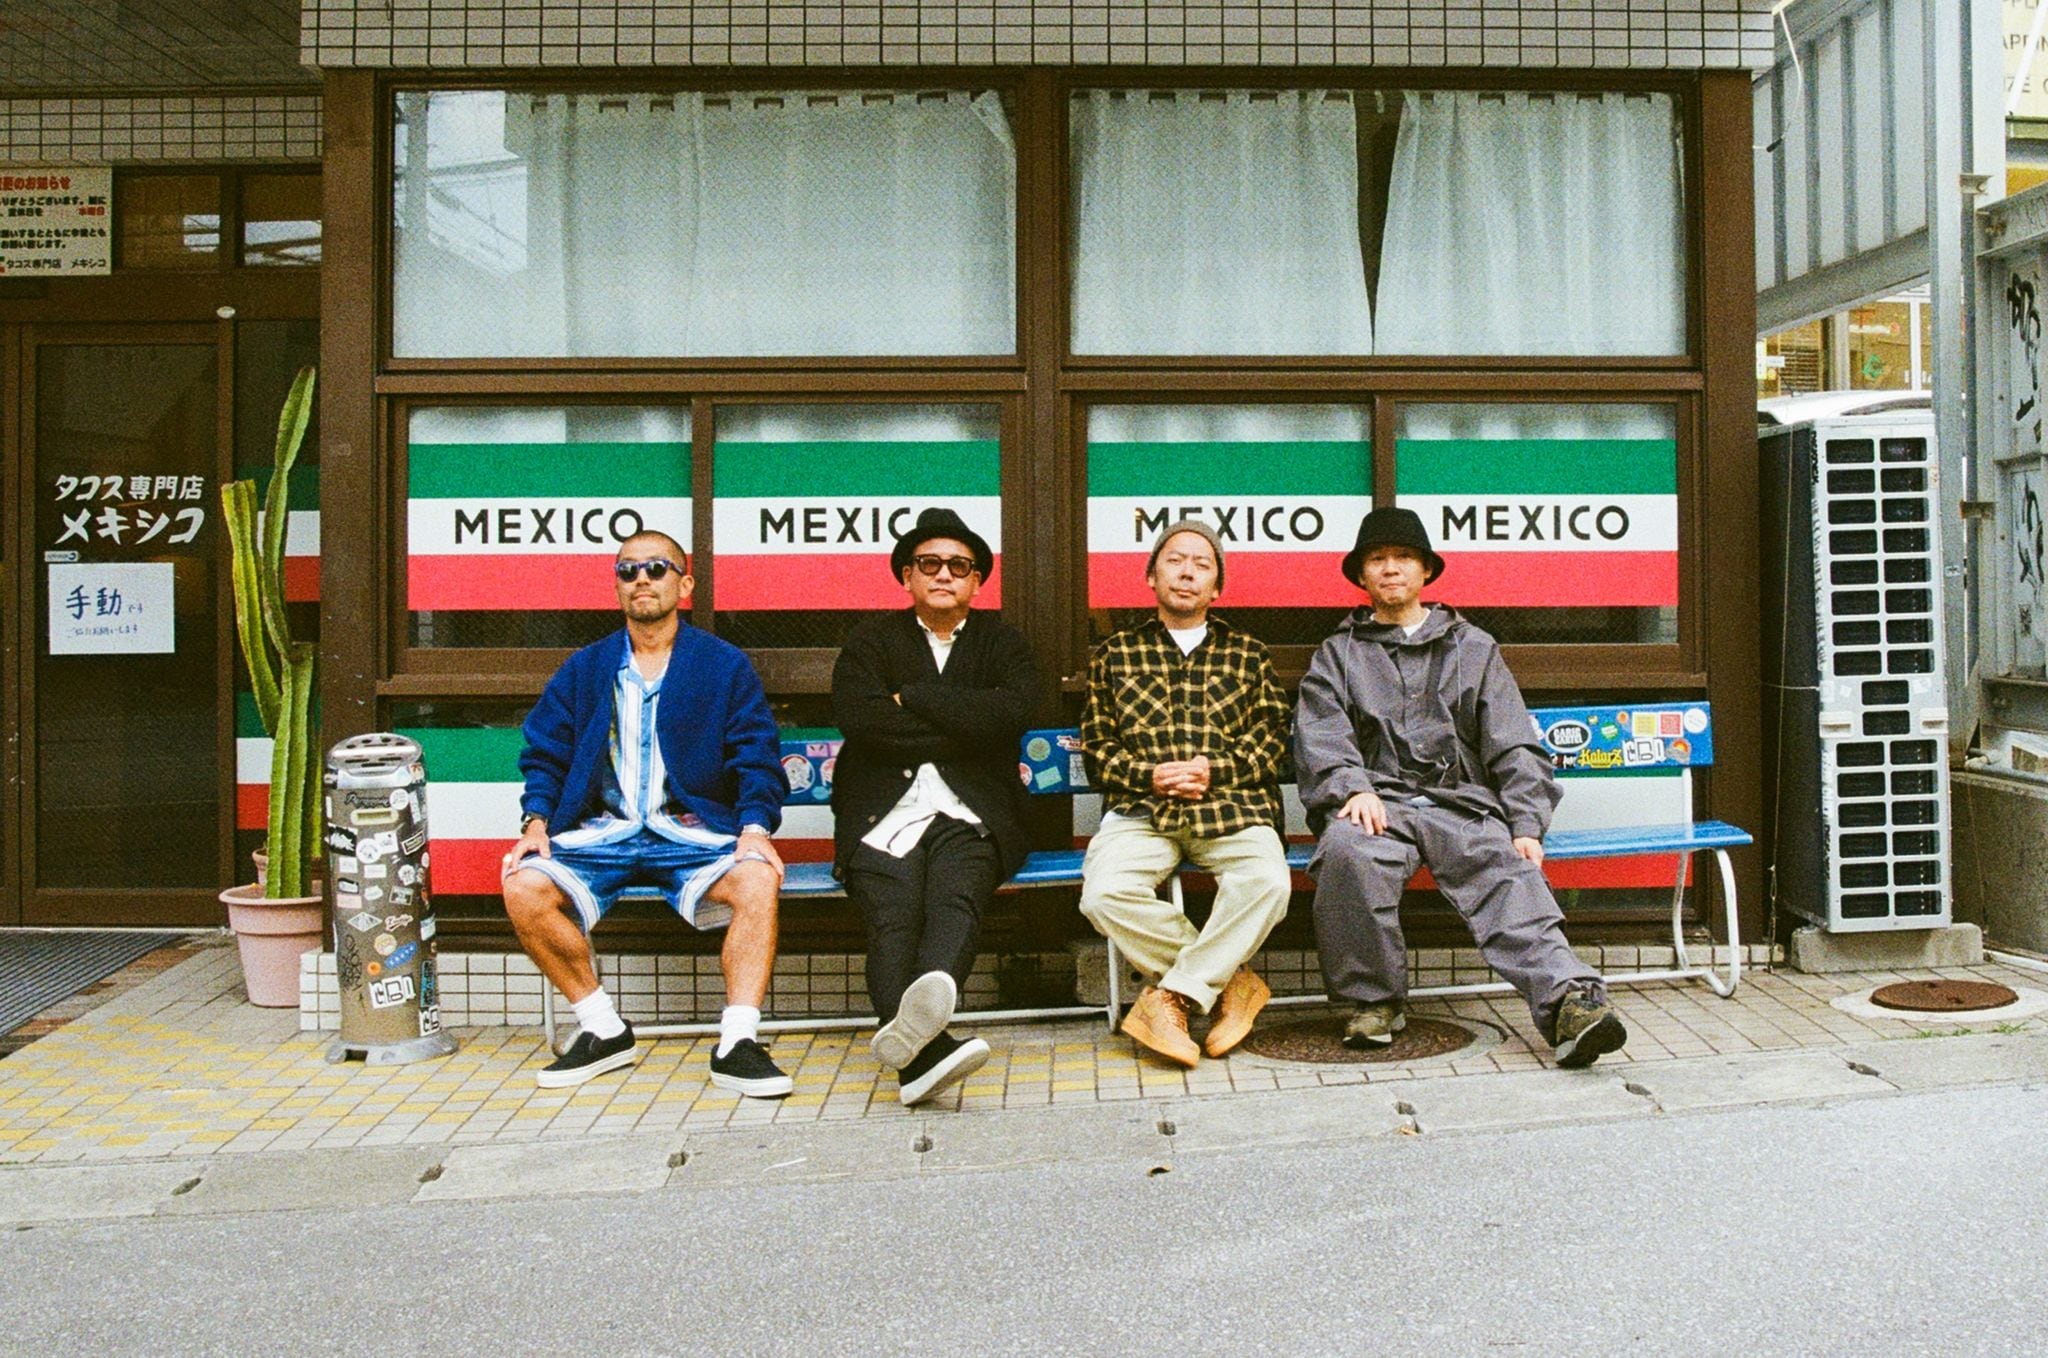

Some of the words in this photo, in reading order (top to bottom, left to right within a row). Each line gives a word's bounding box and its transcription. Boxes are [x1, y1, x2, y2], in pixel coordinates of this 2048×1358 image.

[0, 176, 71, 191] 更のお知らせ
[6, 258, 62, 268] タコス専門店
[71, 258, 106, 268] メキシコ
[55, 474, 205, 501] タコス専門店
[54, 506, 206, 546] メキシコ
[455, 508, 644, 545] MEXICO
[760, 507, 911, 544] MEXIC
[1442, 505, 1631, 542] MEXICO
